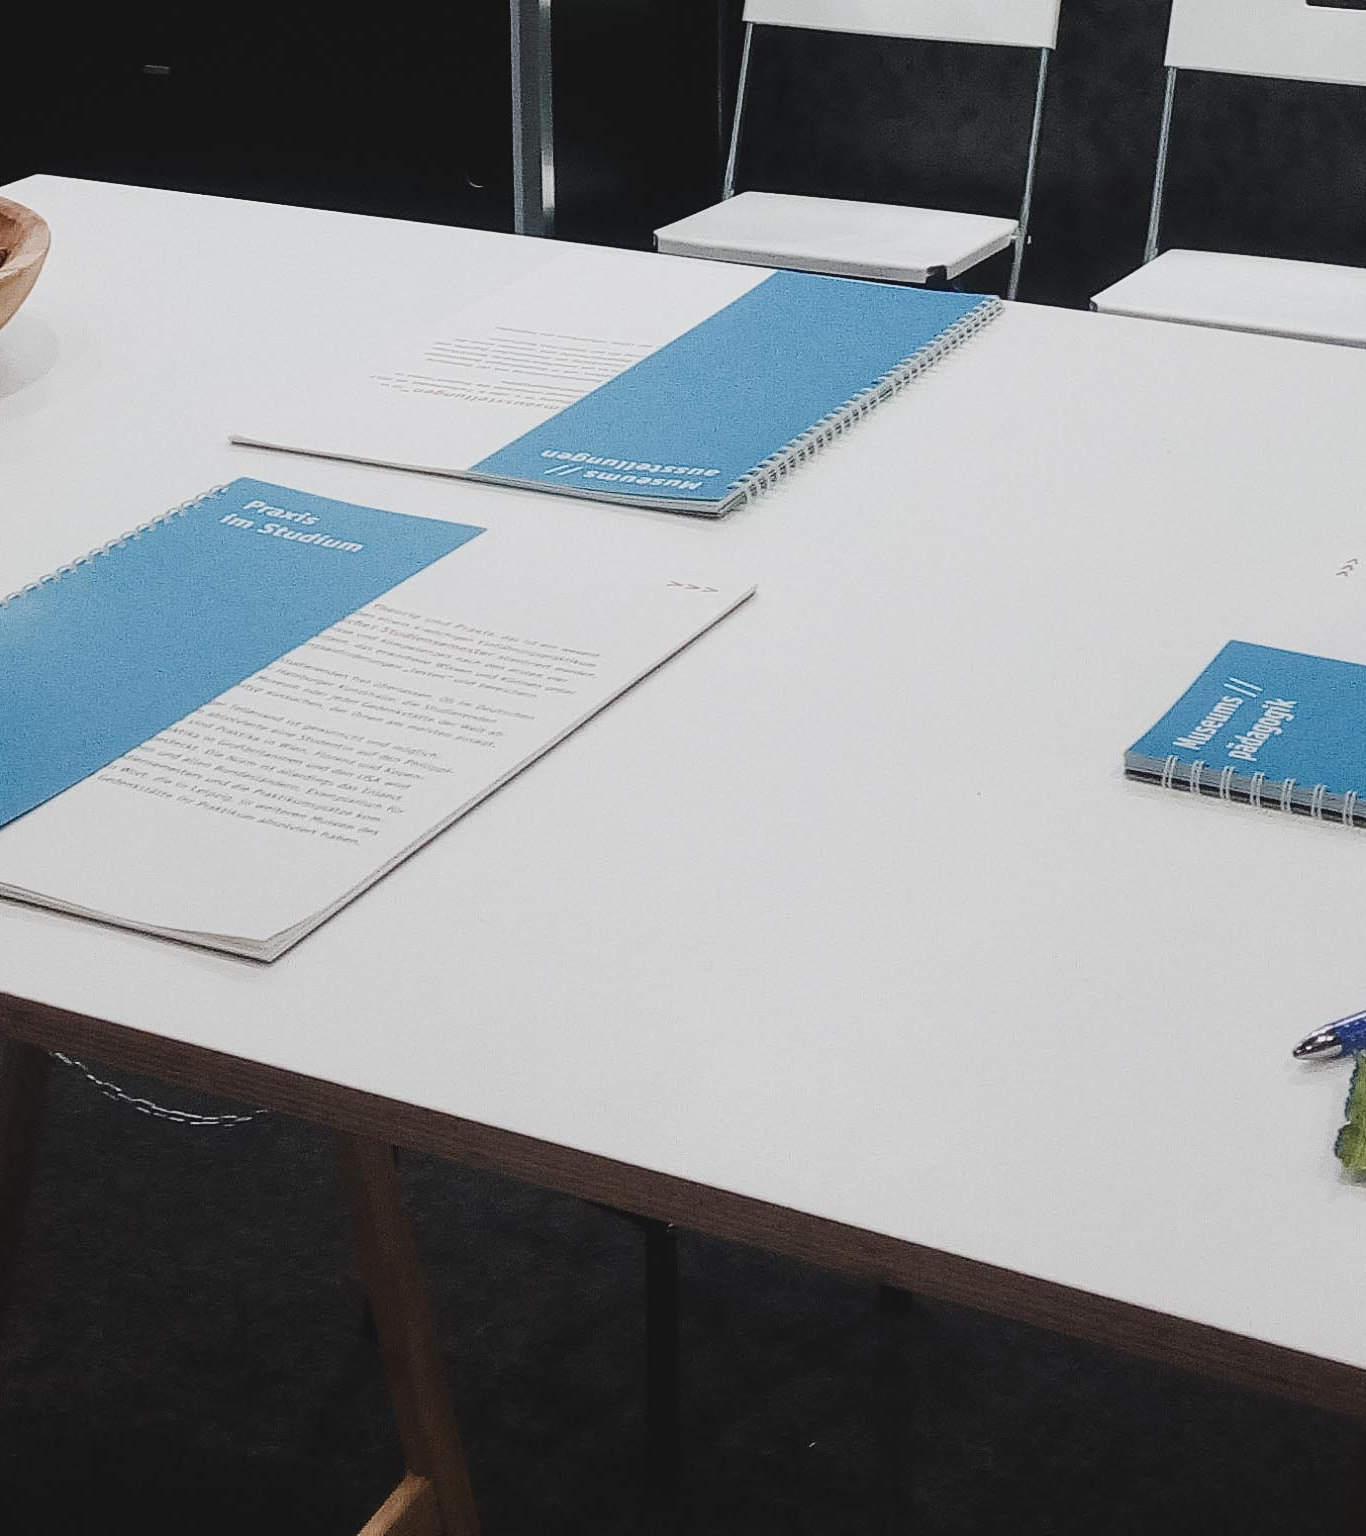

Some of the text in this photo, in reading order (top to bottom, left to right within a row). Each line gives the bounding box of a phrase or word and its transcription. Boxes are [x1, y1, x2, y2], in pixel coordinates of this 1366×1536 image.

[541, 449, 720, 478] ausstellungen
[583, 469, 702, 491] Museums
[242, 500, 320, 525] Praxis
[220, 513, 364, 553] im Studium
[1172, 695, 1244, 751] Museums
[1226, 698, 1298, 762] pädagogik
